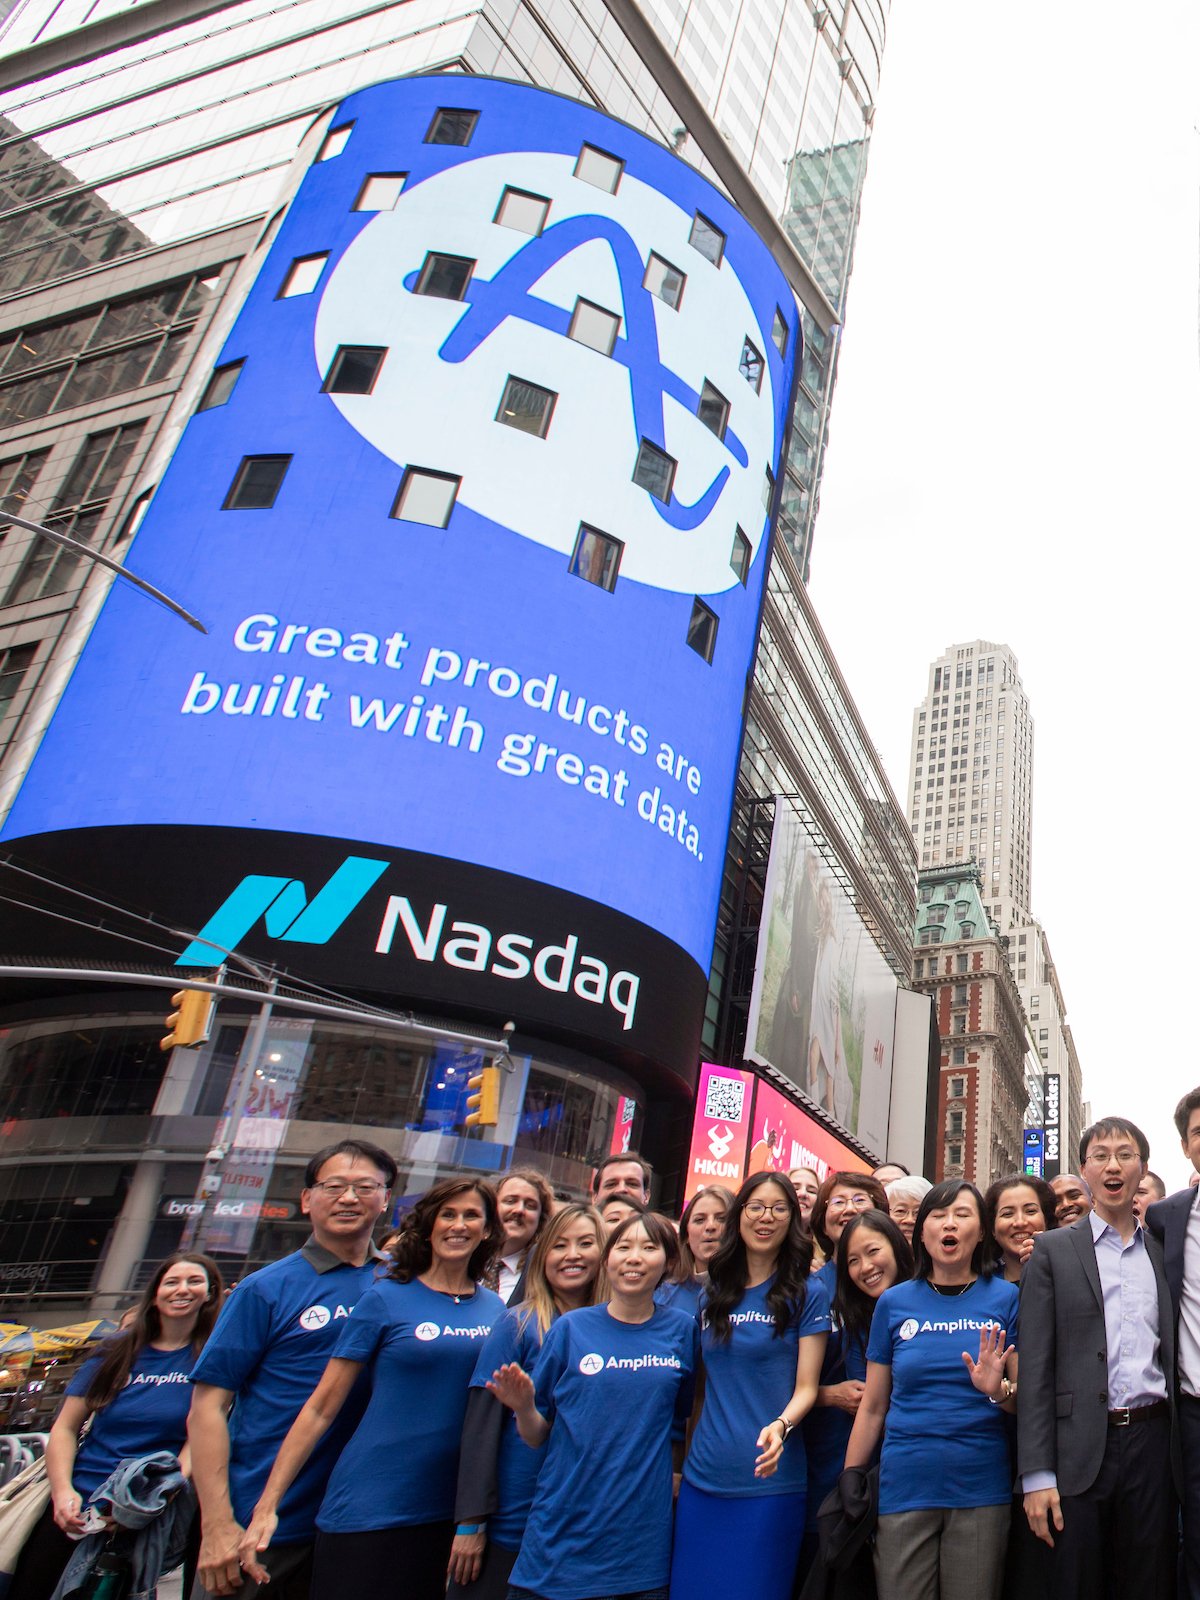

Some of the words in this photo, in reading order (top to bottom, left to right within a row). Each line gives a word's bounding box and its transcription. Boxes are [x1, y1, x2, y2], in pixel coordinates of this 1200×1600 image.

[232, 613, 408, 670] Great
[420, 647, 650, 755] products
[656, 743, 703, 795] are
[180, 672, 330, 722] built
[349, 695, 484, 752] with
[496, 733, 630, 806] great
[637, 786, 705, 862] data.
[375, 894, 641, 1032] Nasdaq
[1044, 1077, 1059, 1126] Locker
[693, 1158, 740, 1178] HKUN
[442, 1325, 493, 1340] Amplit
[919, 1319, 1003, 1335] Amplitude
[605, 1354, 682, 1372] Amplitude
